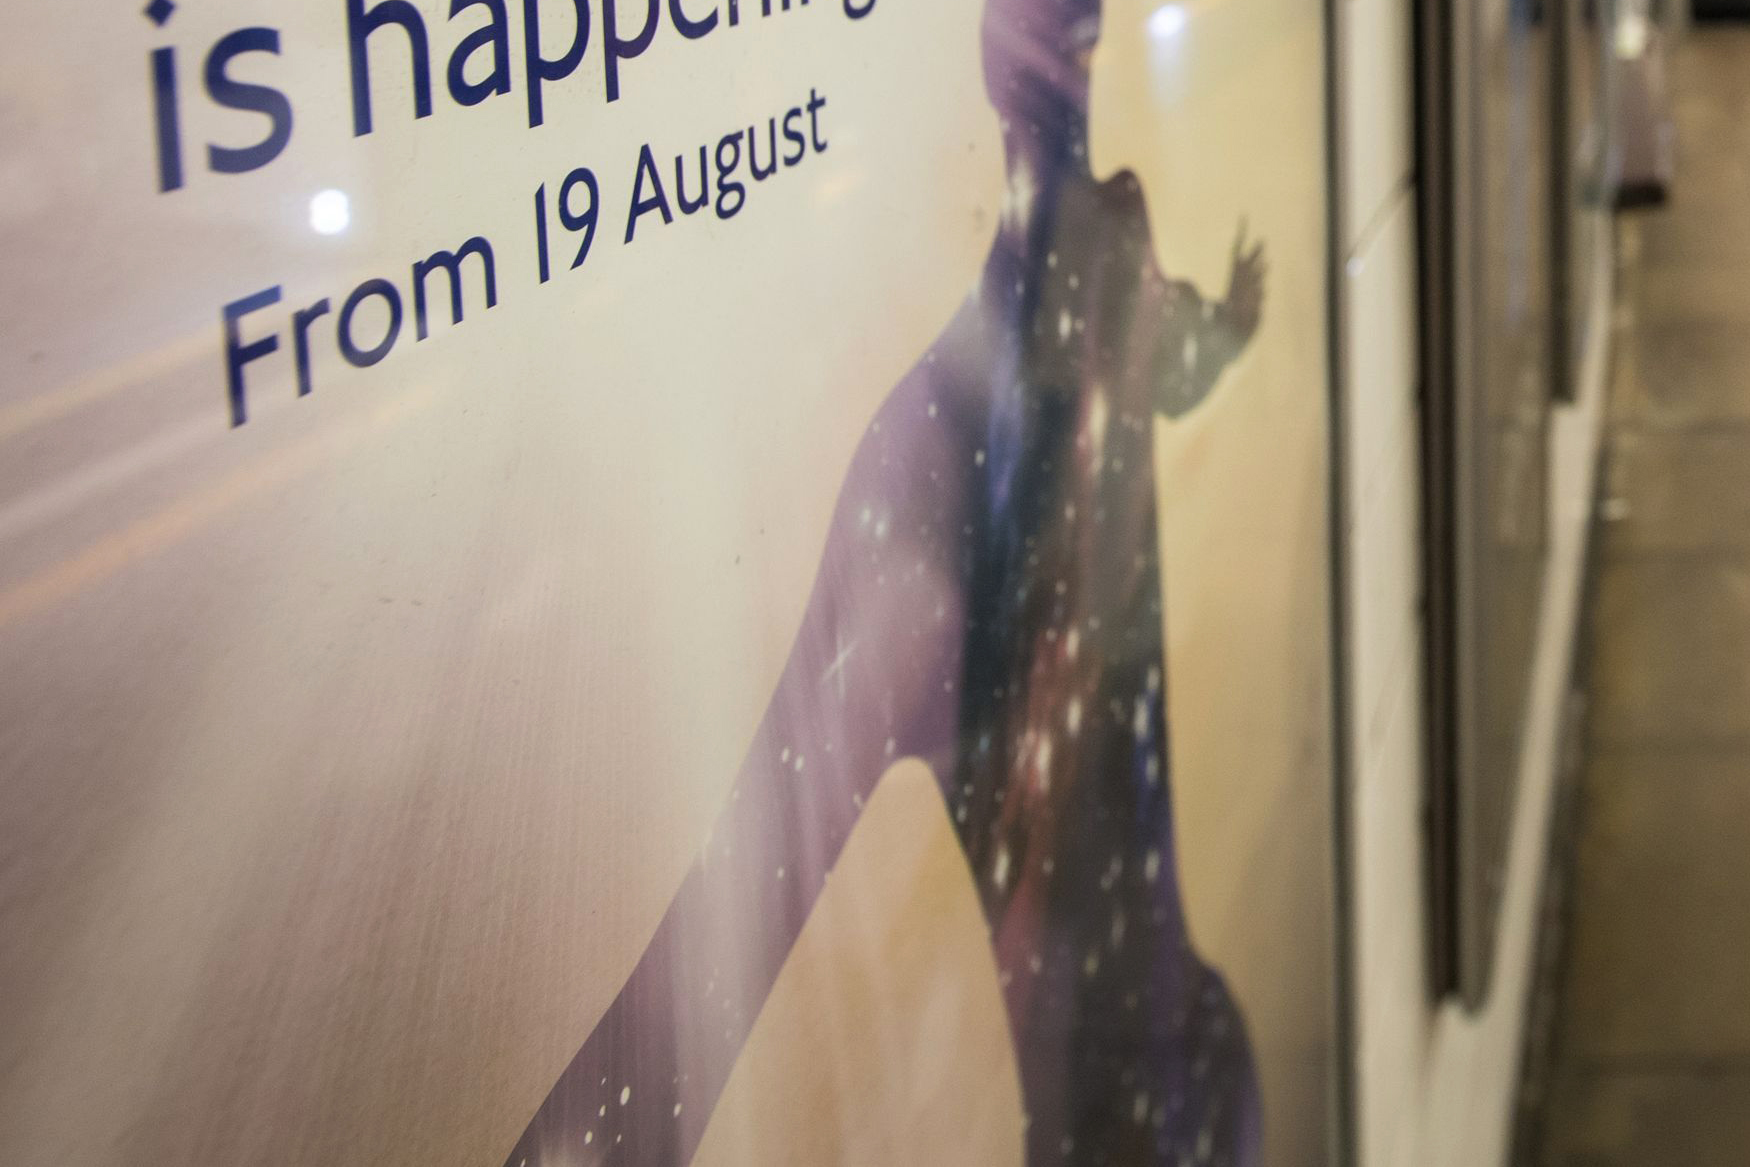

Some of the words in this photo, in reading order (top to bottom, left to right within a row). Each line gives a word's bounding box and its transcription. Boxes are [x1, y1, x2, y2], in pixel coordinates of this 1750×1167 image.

[221, 234, 498, 429] From
[532, 166, 602, 285] 19
[622, 87, 830, 246] August
